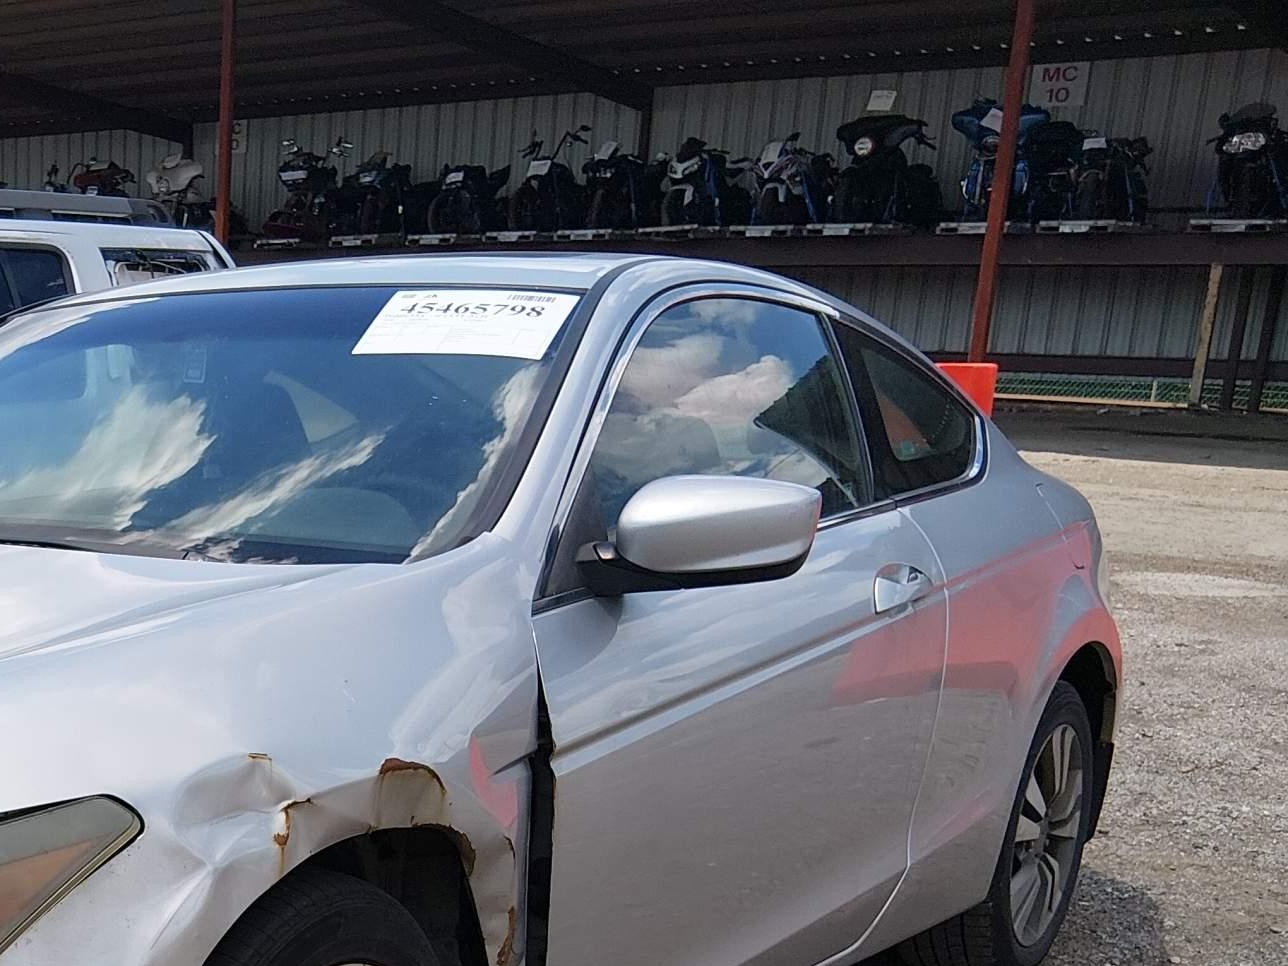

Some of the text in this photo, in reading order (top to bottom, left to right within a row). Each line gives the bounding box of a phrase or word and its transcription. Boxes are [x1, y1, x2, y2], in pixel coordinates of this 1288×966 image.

[1042, 66, 1078, 82] MC
[1046, 87, 1070, 103] 10
[400, 301, 546, 319] 45465798
